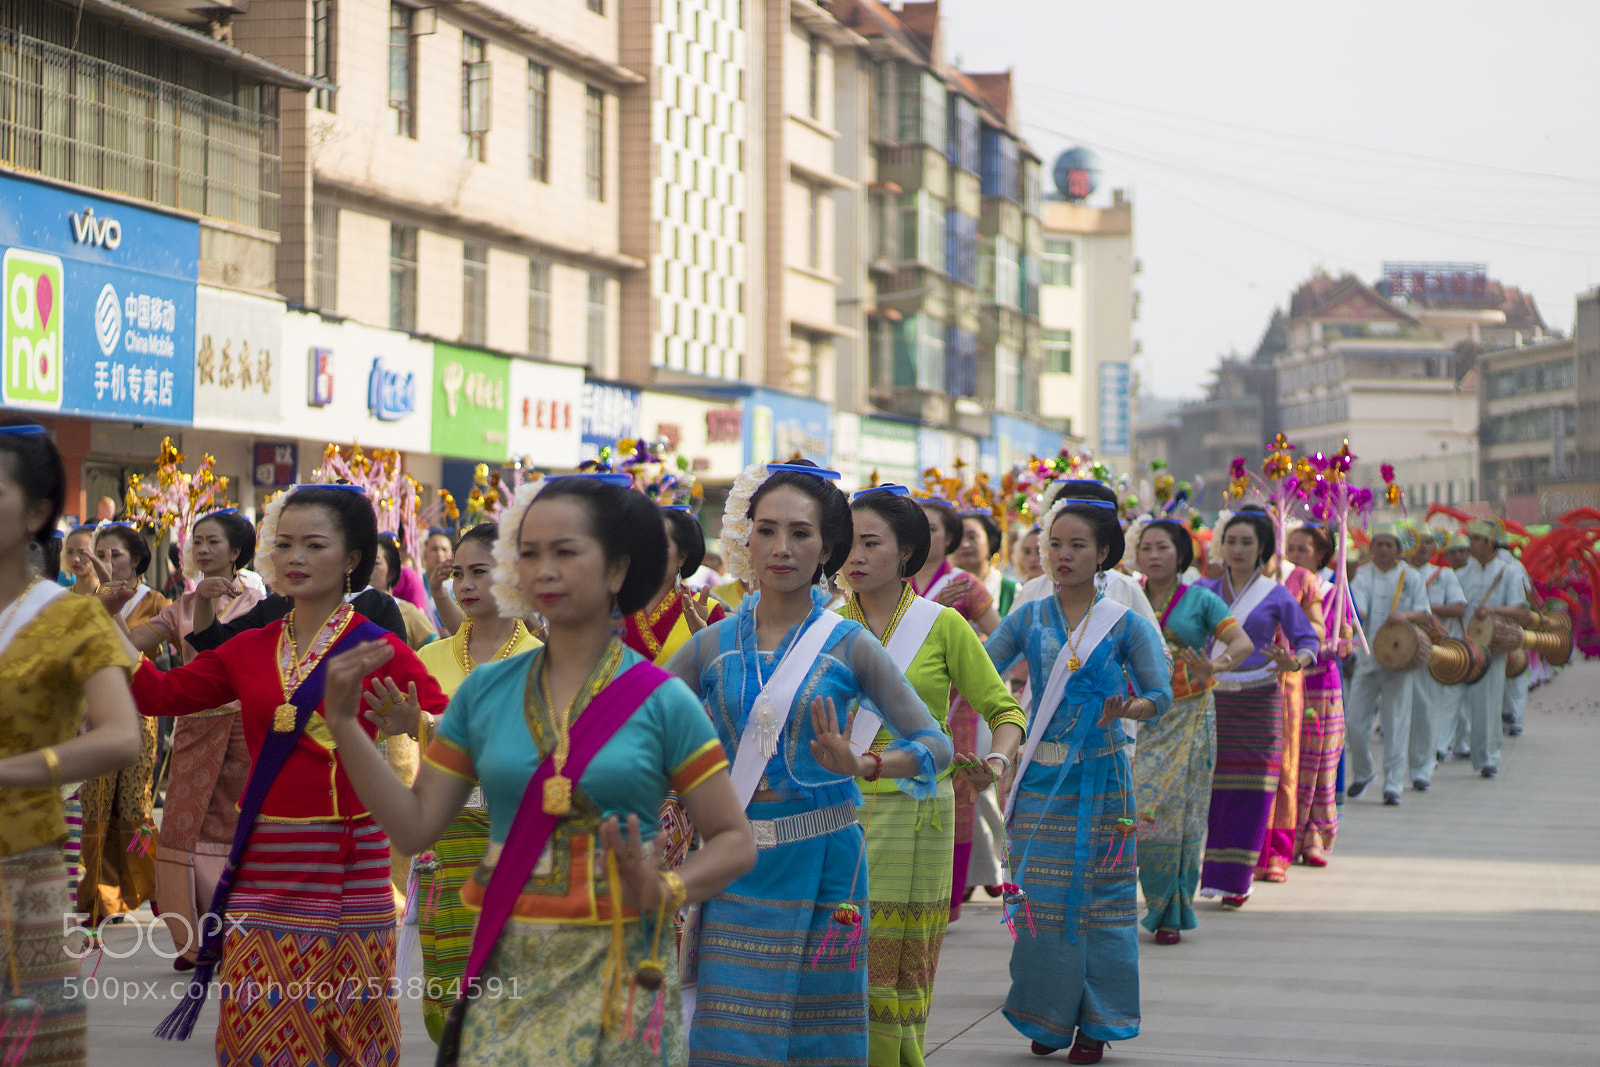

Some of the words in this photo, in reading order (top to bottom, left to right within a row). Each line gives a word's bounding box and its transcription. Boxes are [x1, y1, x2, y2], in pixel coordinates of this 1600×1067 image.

[70, 207, 121, 249] vivo
[125, 291, 175, 332] 中国移动
[125, 330, 151, 353] China
[150, 333, 174, 358] Mobile
[94, 361, 174, 406] 手机专卖店
